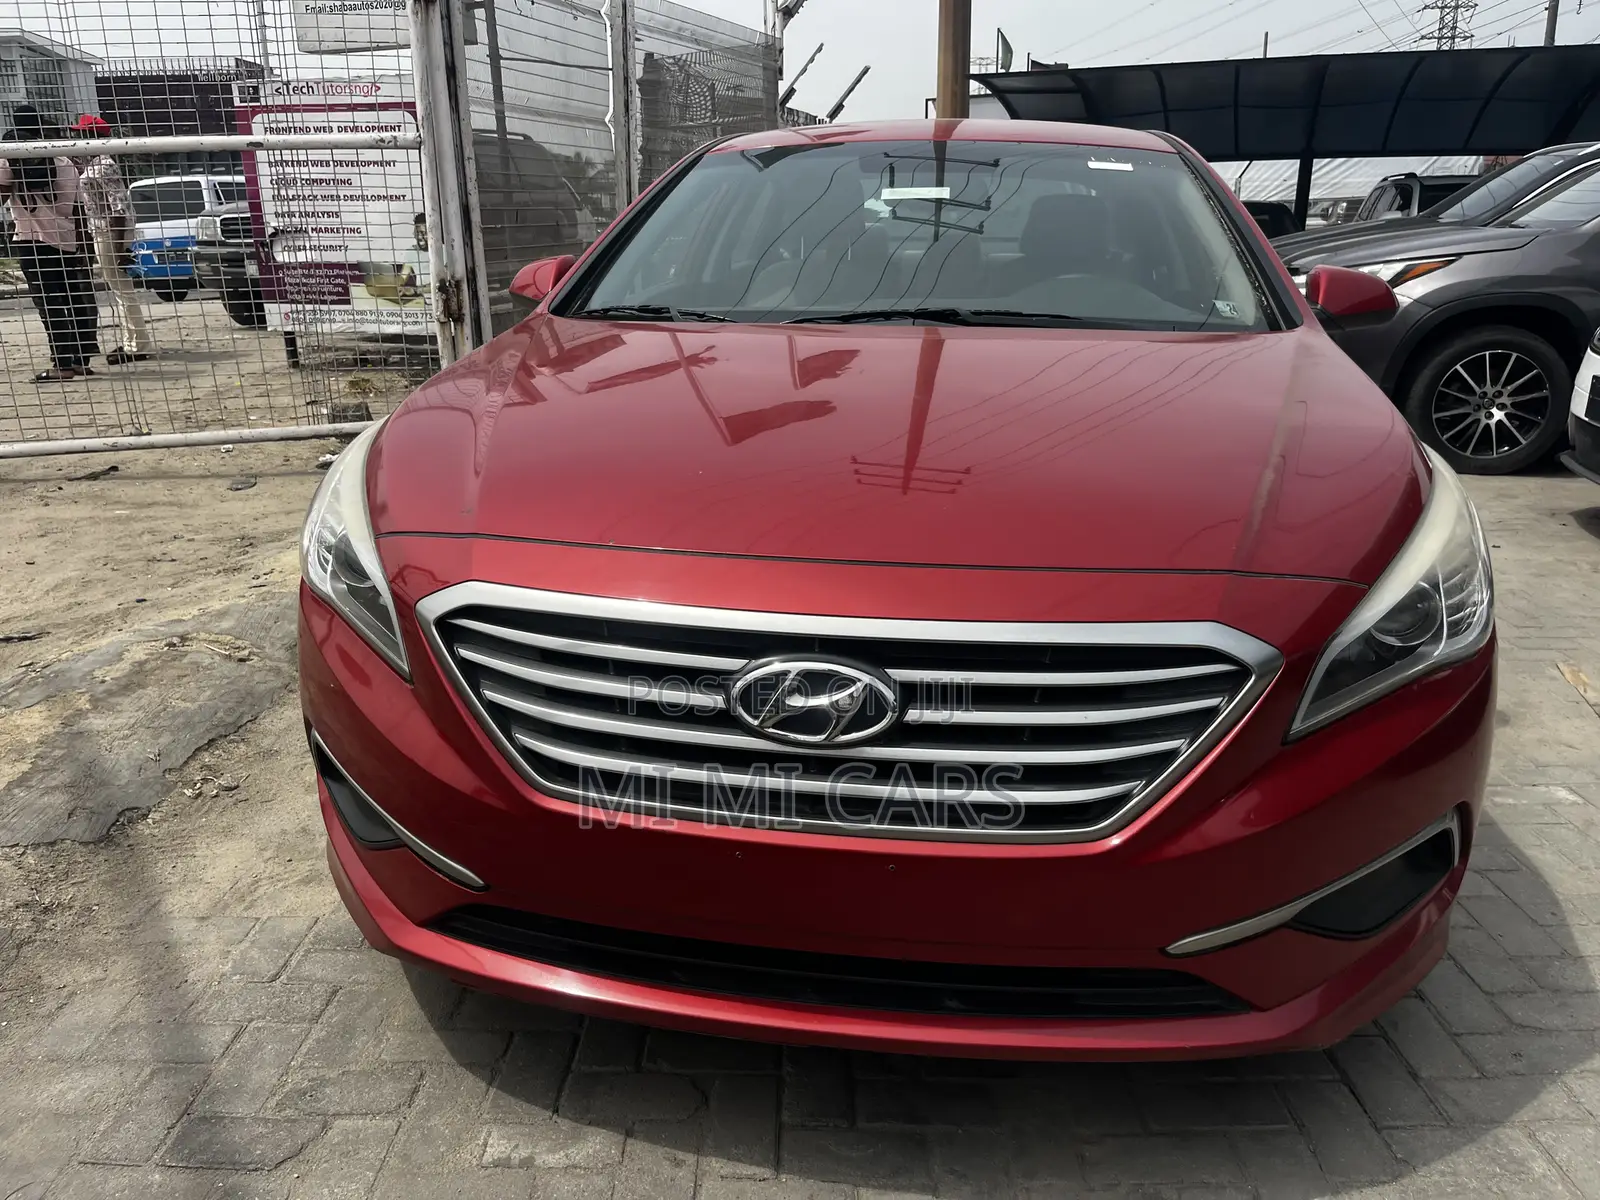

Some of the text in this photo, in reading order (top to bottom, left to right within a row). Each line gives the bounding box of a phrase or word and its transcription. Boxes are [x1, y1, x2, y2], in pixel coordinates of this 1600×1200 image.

[264, 125, 402, 135] FRONTEND WEB DEVELOPMENT
[268, 160, 397, 168] BACKEND WEB DEVELOPMENT
[270, 178, 352, 186] CLOUD COMPUTING
[320, 194, 341, 202] WEB
[343, 194, 407, 202] DEVELOPMENT
[299, 211, 340, 219] ANALYSIS
[311, 227, 362, 235] MARKETING
[309, 244, 349, 252] SECURITY
